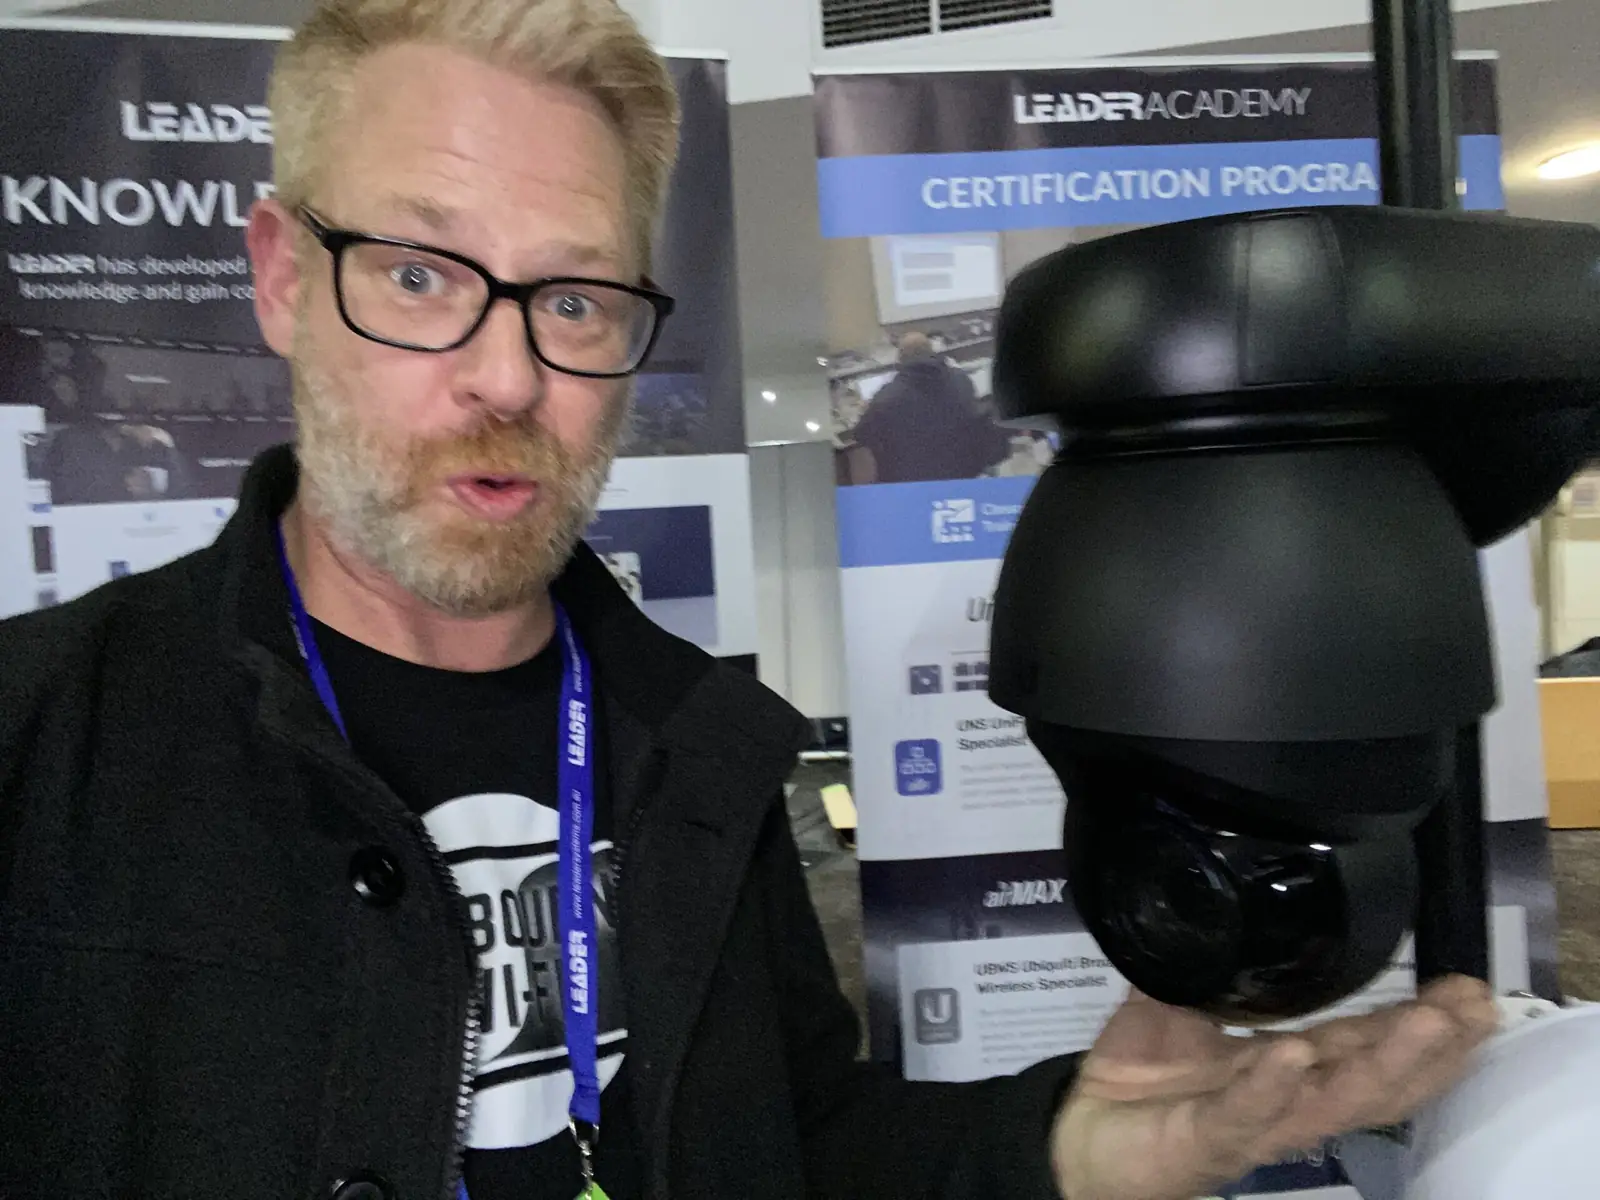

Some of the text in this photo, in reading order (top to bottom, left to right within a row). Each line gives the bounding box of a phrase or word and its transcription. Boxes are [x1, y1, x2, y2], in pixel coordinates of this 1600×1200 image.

[921, 168, 1210, 209] CERTIFICATION
[97, 253, 139, 275] has
[138, 254, 248, 278] developed
[18, 278, 139, 304] knowledge
[140, 280, 182, 301] and
[183, 280, 230, 304] gain
[567, 698, 586, 767] LEADER
[568, 929, 589, 1014] LEADER
[975, 976, 1109, 995] Wireless Specialist
